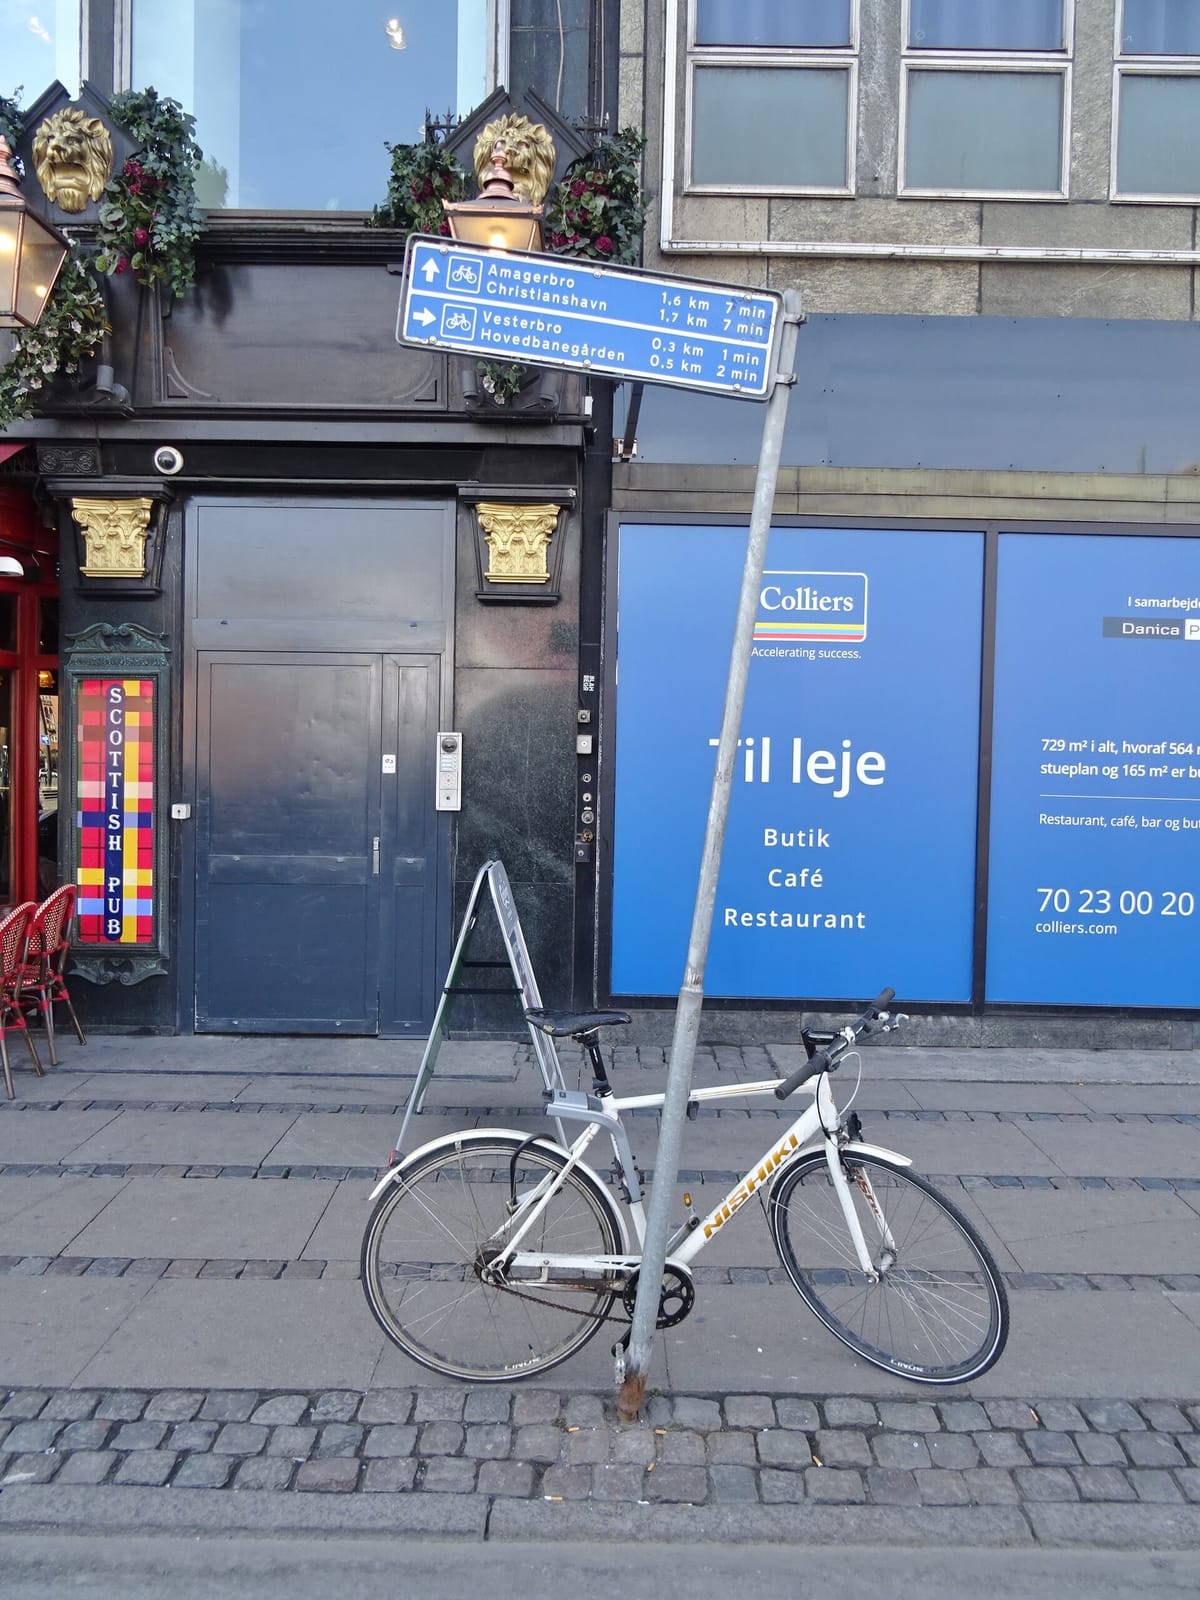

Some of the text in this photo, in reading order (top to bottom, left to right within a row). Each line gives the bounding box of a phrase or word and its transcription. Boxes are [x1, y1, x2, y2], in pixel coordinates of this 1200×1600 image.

[487, 263, 575, 289] Amagerbro
[688, 296, 709, 311] km
[725, 301, 734, 314] 7
[739, 305, 766, 319] min
[486, 280, 607, 311] Christianshavn
[686, 313, 708, 328] km
[723, 318, 732, 331] 7
[736, 323, 764, 337] min
[483, 310, 562, 334] Vesterbro
[683, 342, 704, 357] km
[722, 348, 728, 361] 1
[732, 353, 760, 366] min
[481, 327, 625, 362] Hovedbanegården
[680, 359, 702, 374] km
[716, 364, 726, 377] 2
[731, 369, 757, 382] min
[760, 586, 853, 611] Colliers
[1128, 597, 1132, 606] I
[1123, 623, 1200, 636] Danica P
[751, 646, 862, 660] Accelerating success.
[1042, 739, 1065, 751] 729
[1069, 740, 1088, 751] m²
[1091, 740, 1095, 752] i
[1098, 740, 1119, 754] alt,
[1122, 741, 1168, 753] hvoraf
[1169, 743, 1193, 754] 564
[793, 737, 885, 797] leje
[1041, 763, 1200, 779] stueplan og 165 m² er b
[107, 687, 123, 935] SCOTTISH PUB
[1040, 814, 1107, 827] Restaurant,
[1111, 816, 1137, 828] café,
[1142, 816, 1162, 827] bar
[1165, 820, 1180, 831] og
[764, 828, 830, 847] Butik
[768, 867, 823, 887] Café
[1038, 889, 1195, 915] 70 23 00 20
[725, 908, 866, 928] Restaurant
[1035, 921, 1117, 933] colliers.com
[703, 1133, 798, 1239] NISHIKI
